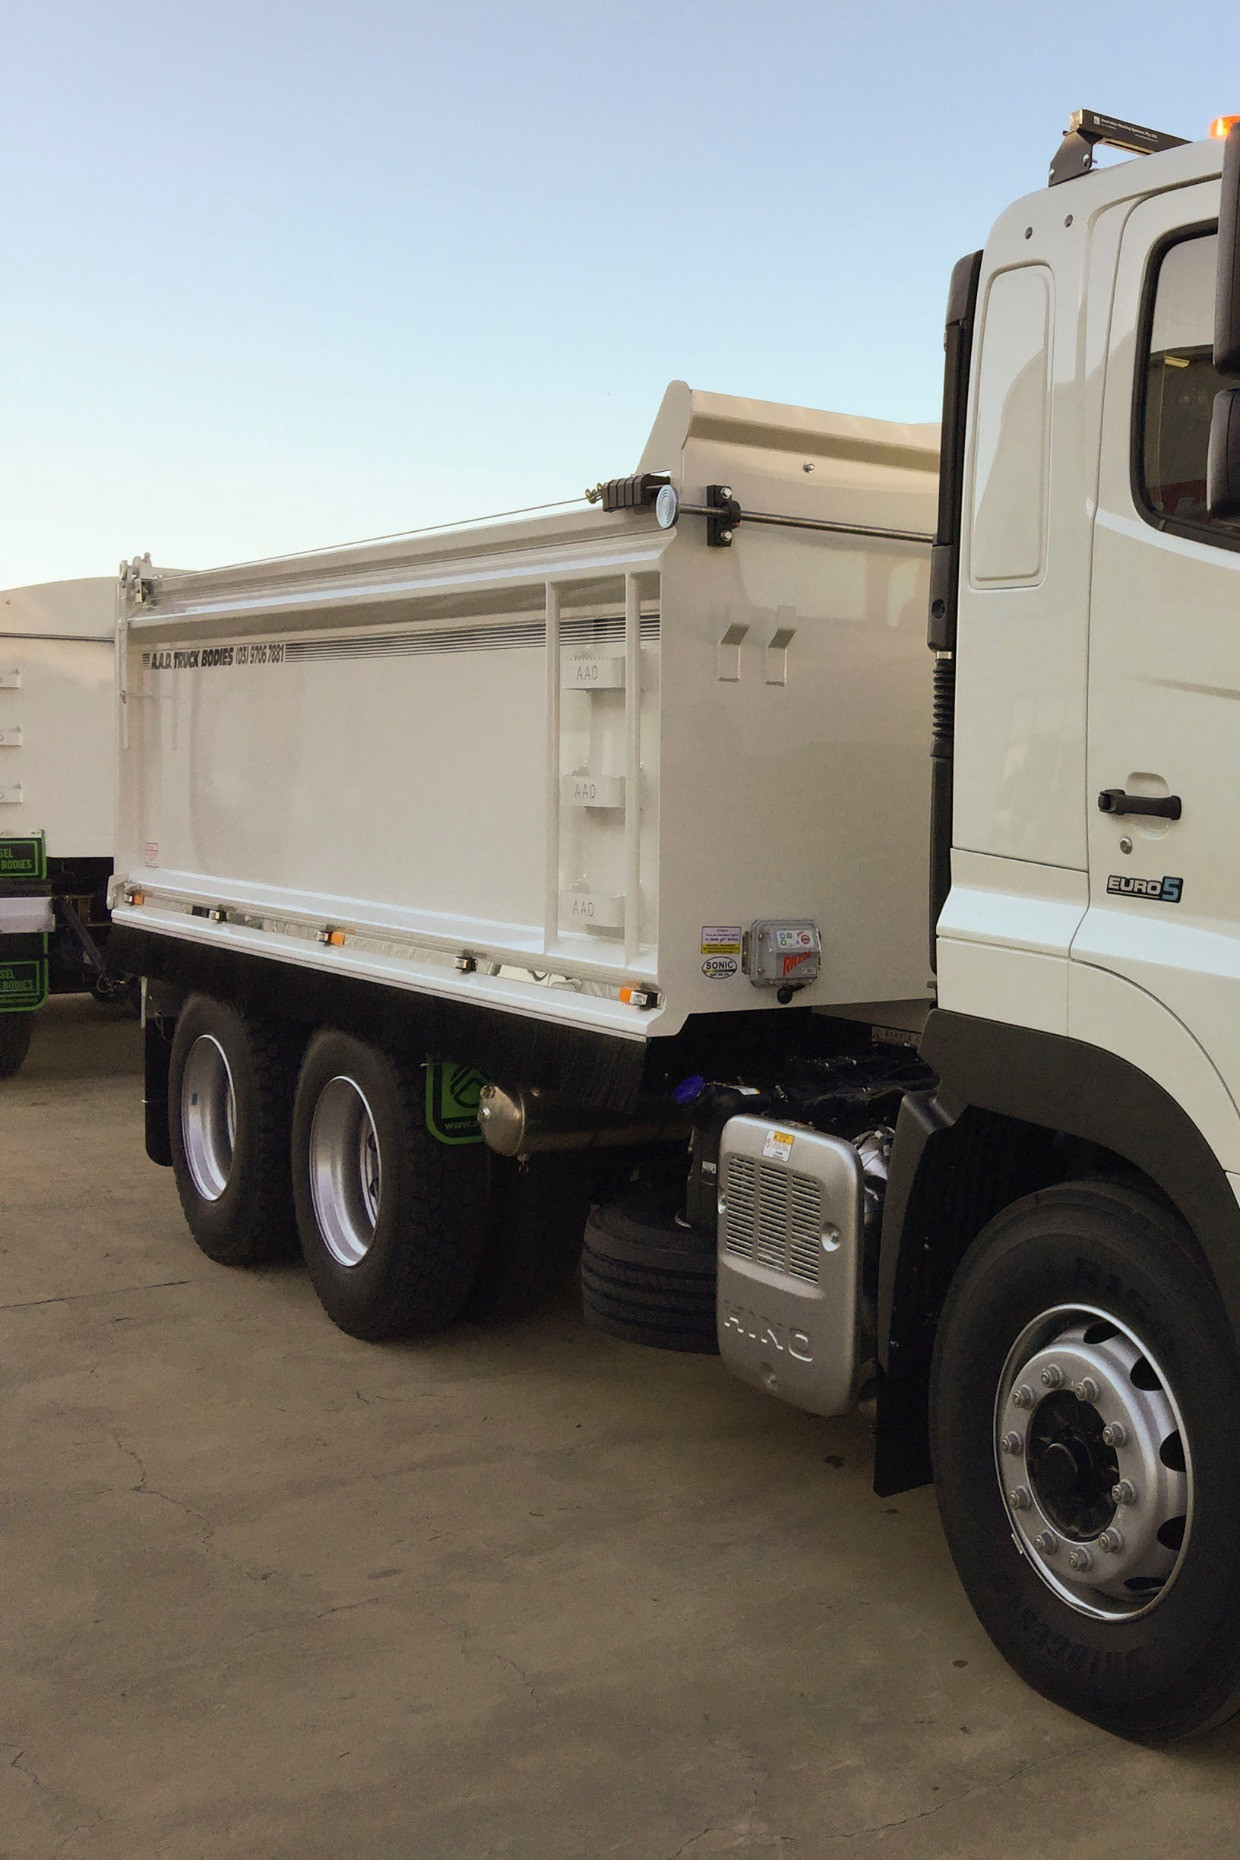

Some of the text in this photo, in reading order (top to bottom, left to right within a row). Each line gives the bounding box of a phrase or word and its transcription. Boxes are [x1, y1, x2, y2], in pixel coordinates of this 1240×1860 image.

[173, 650, 200, 669] TRUCK
[201, 647, 234, 667] BODIES
[235, 646, 249, 665] (03)
[250, 645, 267, 664] 9706
[576, 665, 599, 681] AAD
[575, 783, 597, 799] AAD
[1, 859, 32, 870] BODIES
[572, 900, 594, 917] AAD
[706, 961, 734, 970] SONIC
